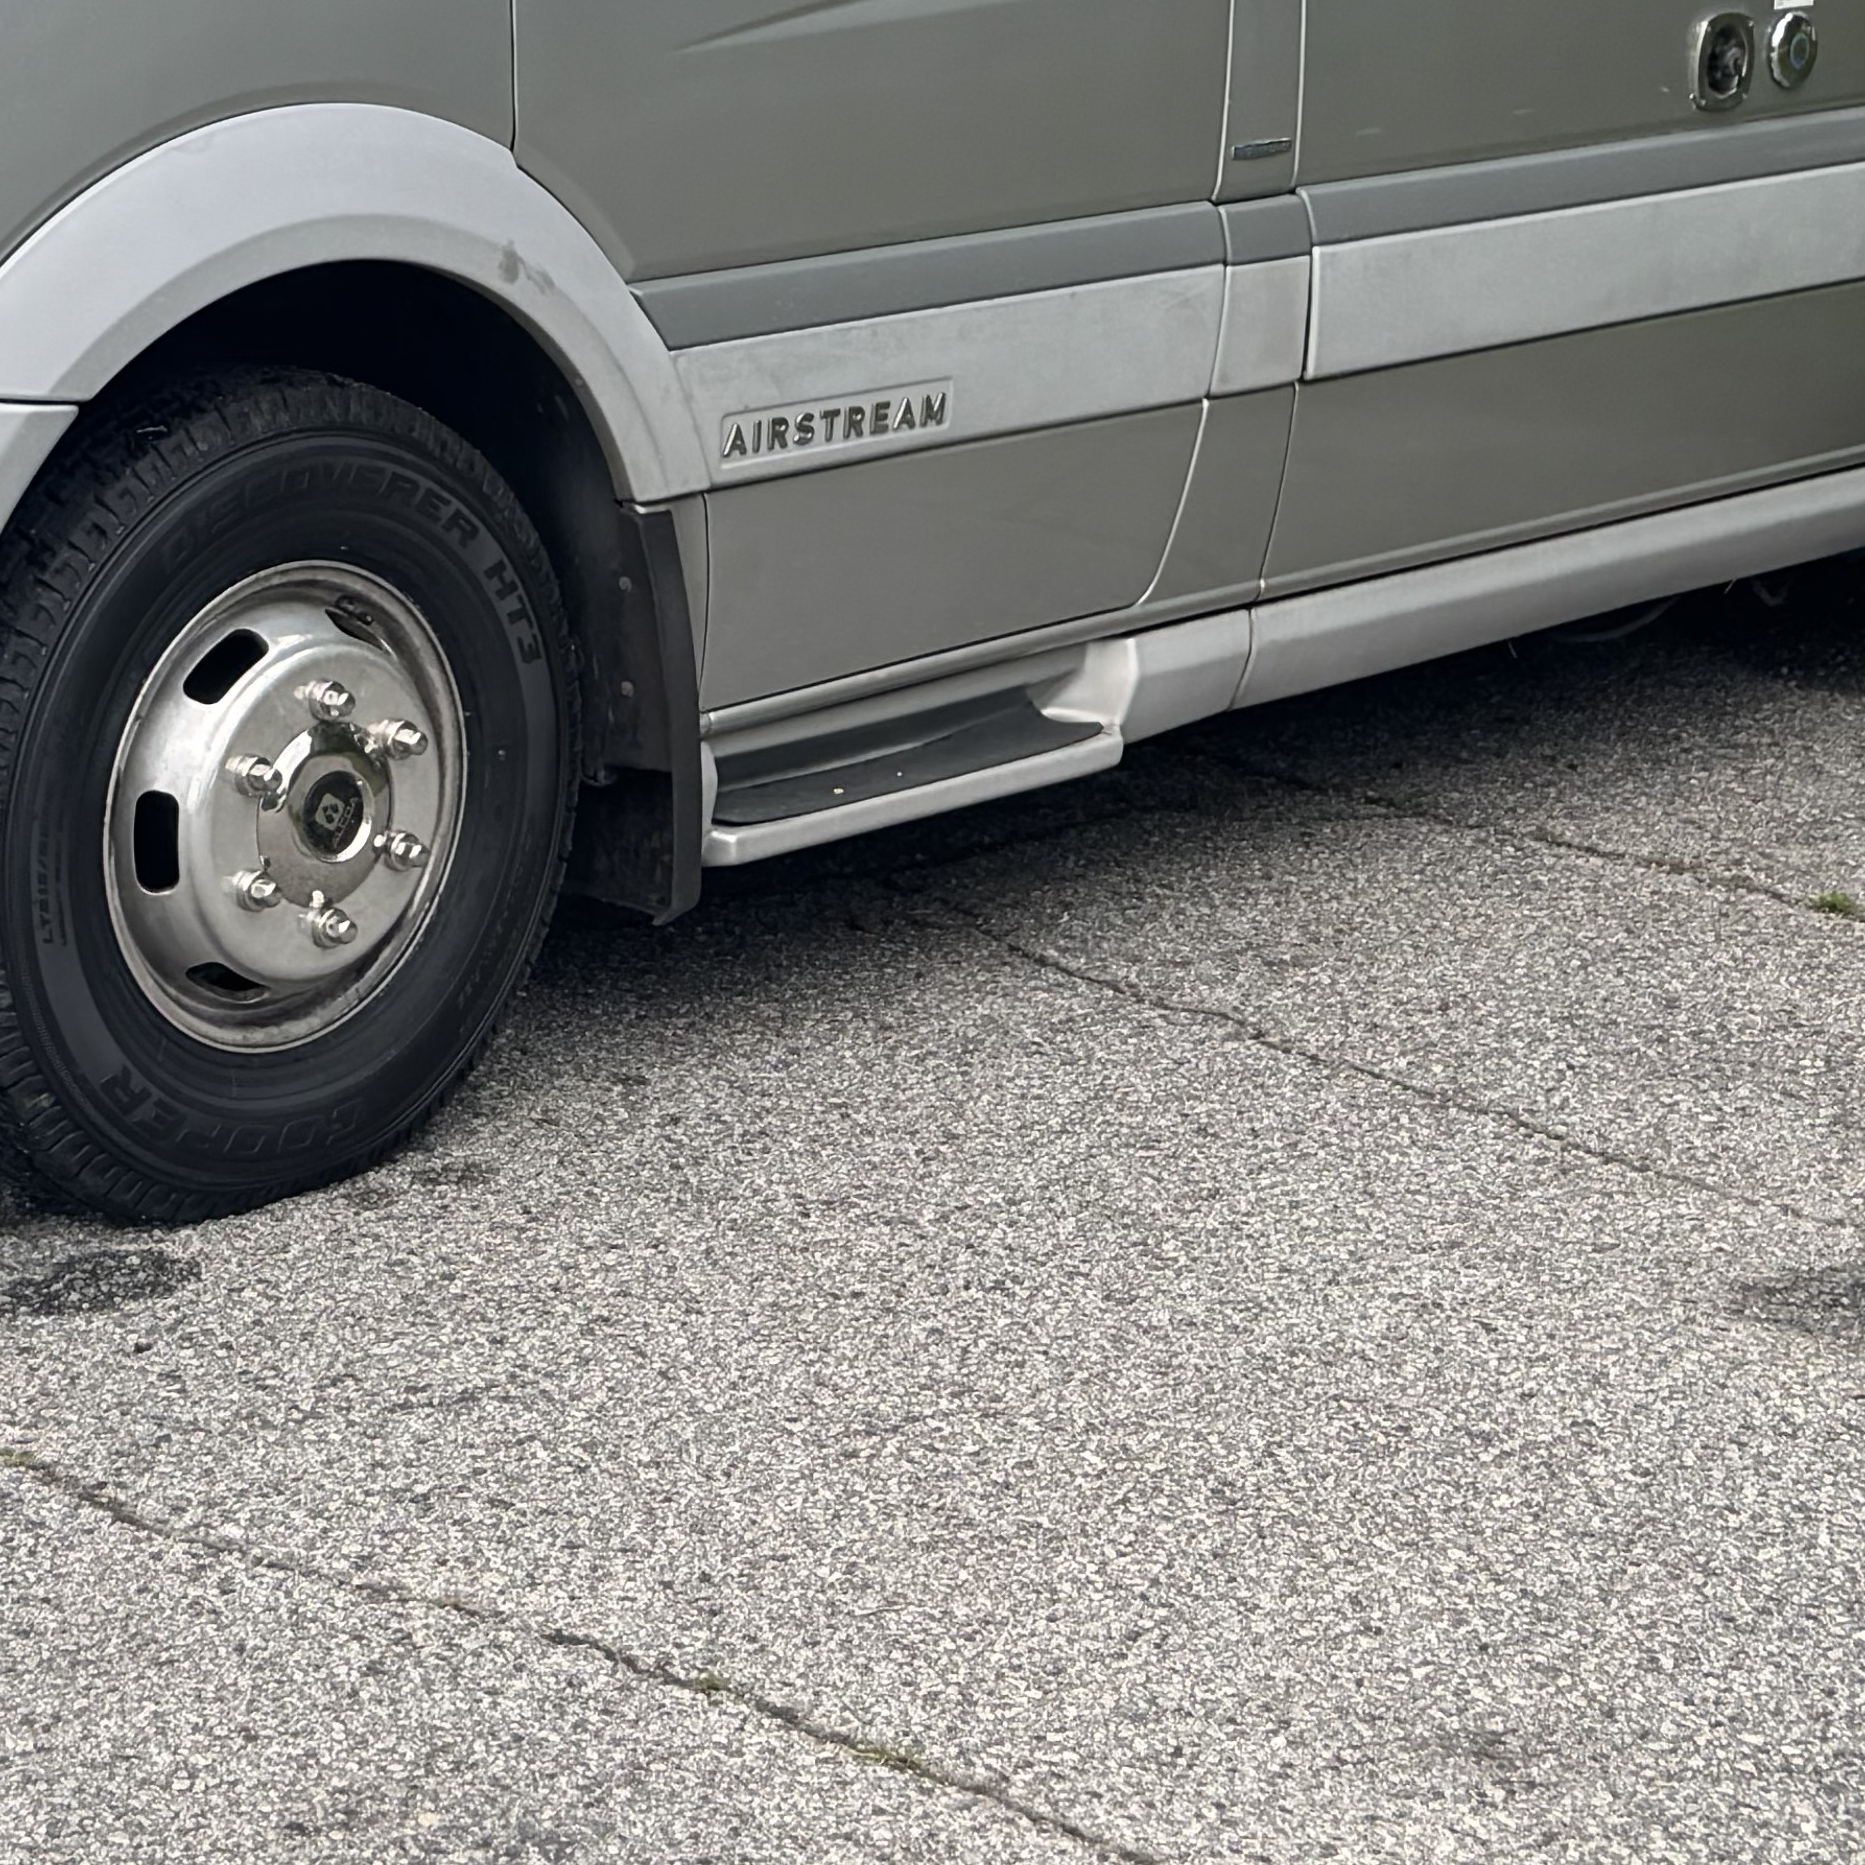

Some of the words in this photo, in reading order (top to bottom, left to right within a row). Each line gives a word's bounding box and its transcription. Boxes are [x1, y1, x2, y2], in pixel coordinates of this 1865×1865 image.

[722, 392, 947, 458] AIRSTREAM
[162, 459, 480, 567] DISCOVERER
[483, 561, 541, 664] HT3
[100, 1065, 367, 1153] COOPER
